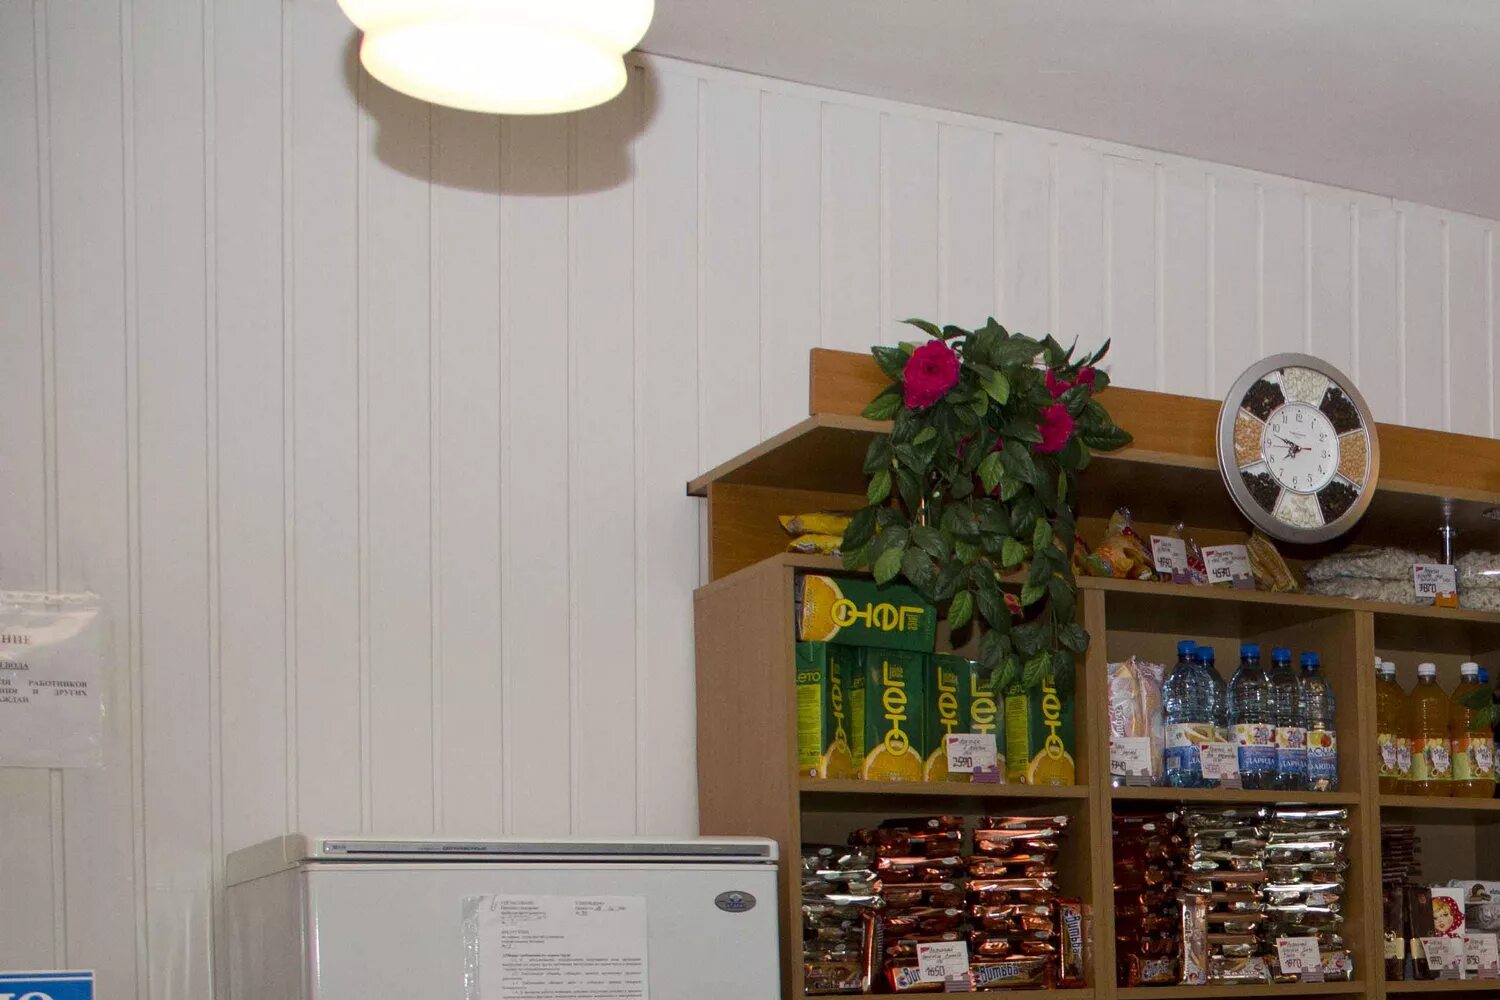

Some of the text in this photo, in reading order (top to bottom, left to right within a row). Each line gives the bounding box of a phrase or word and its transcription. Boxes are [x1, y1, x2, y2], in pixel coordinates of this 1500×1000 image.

[1282, 414, 1288, 424] 11
[1295, 414, 1304, 423] 12
[1272, 423, 1280, 432] 10
[1266, 439, 1272, 447] 9
[1269, 454, 1275, 463] 8
[1279, 468, 1284, 477] 7
[1292, 475, 1298, 484] 6
[1307, 473, 1312, 482] 5
[28, 680, 87, 688] РАБОТНИКОВ
